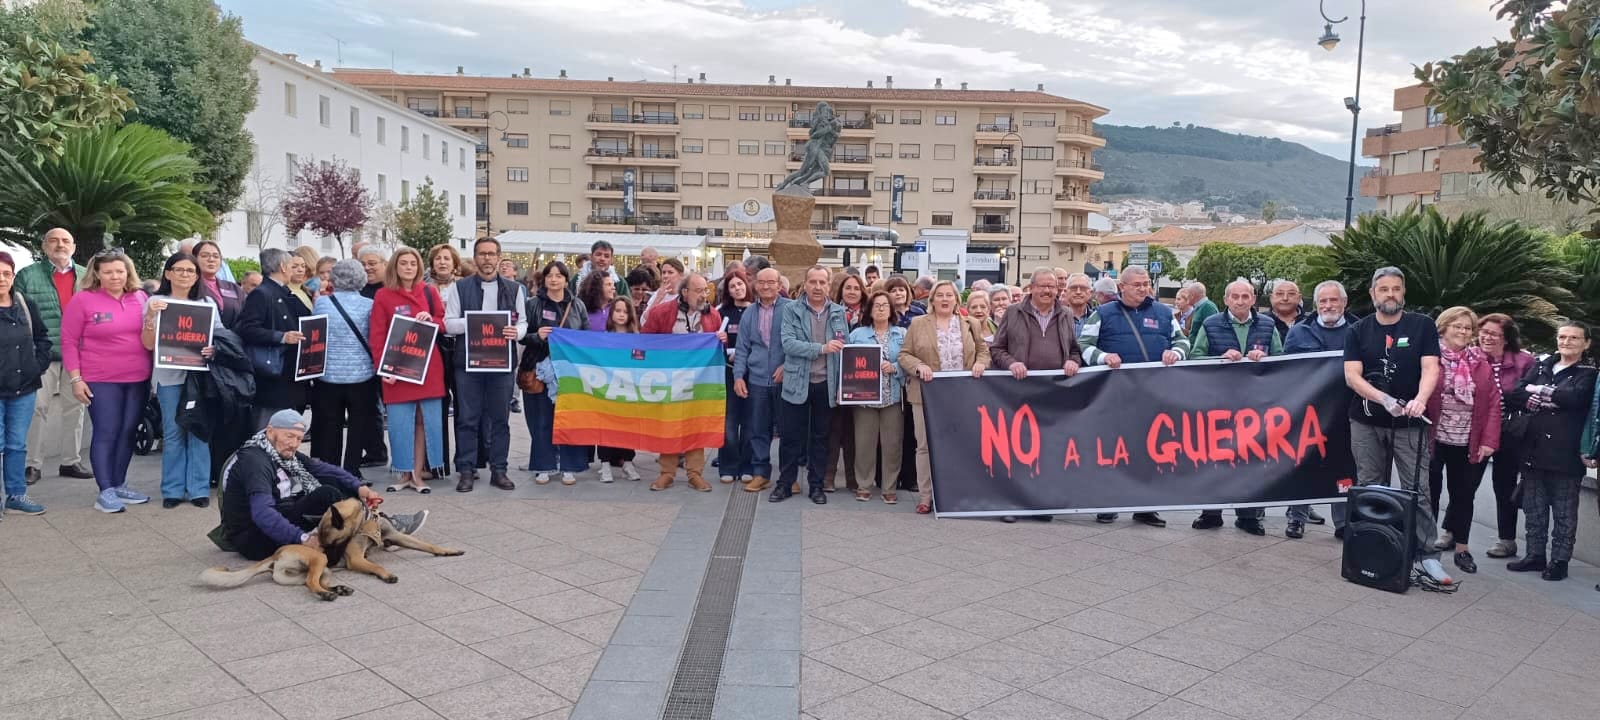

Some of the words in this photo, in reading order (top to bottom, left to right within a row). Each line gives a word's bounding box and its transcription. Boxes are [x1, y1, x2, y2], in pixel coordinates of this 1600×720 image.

[178, 315, 193, 329] NO
[482, 323, 494, 336] NO
[175, 331, 207, 343] GUERRA
[405, 331, 417, 343] NO
[482, 337, 507, 347] GUERRA
[400, 345, 426, 358] GUERRA
[855, 356, 867, 369] NO
[854, 370, 878, 380] GUERRA
[577, 365, 696, 402] PACE
[977, 403, 1041, 479] NO
[1063, 437, 1080, 471] A
[1096, 435, 1130, 469] LA
[1146, 404, 1328, 473] GUERRA
